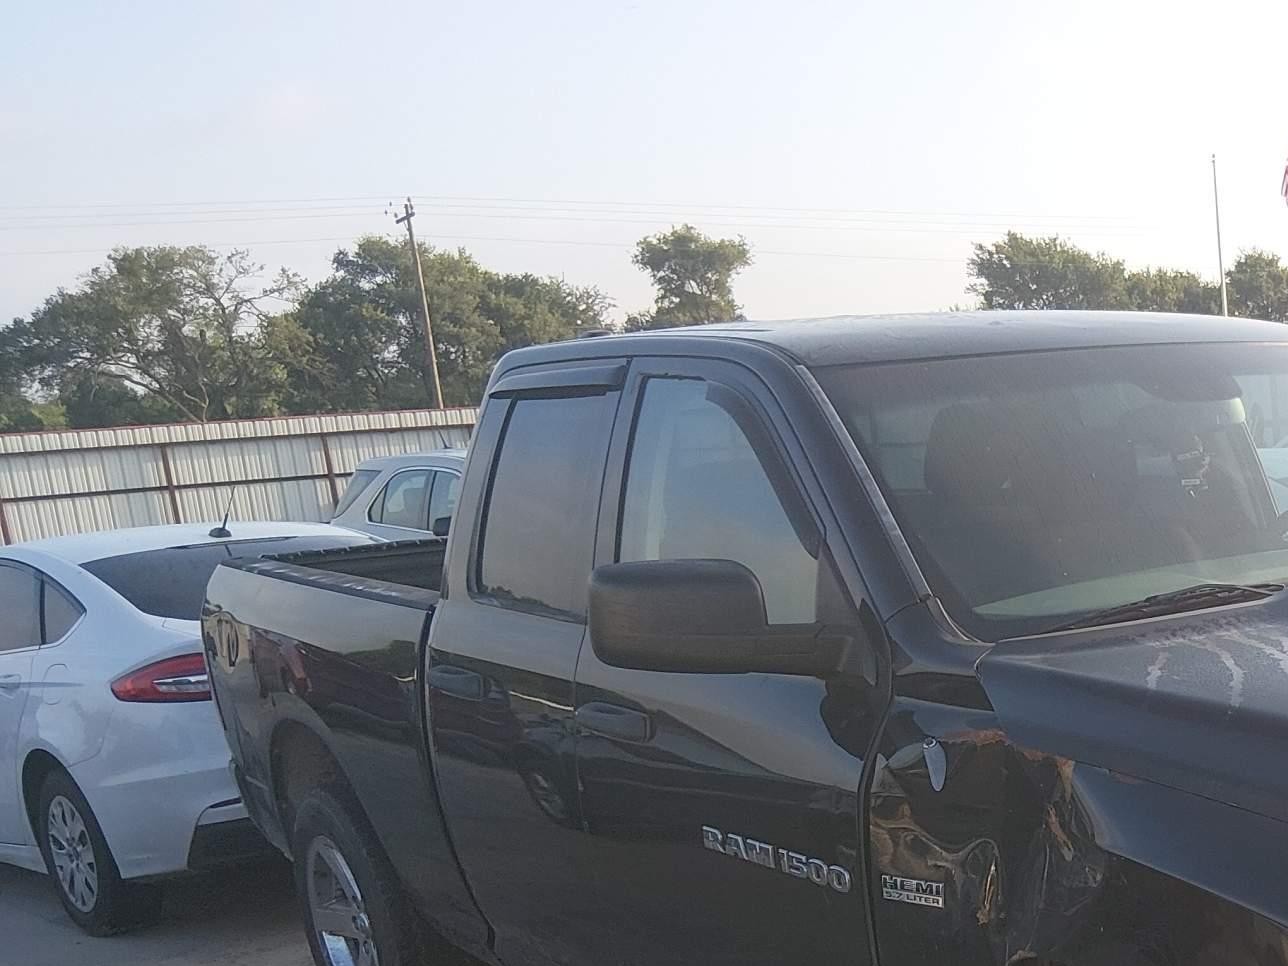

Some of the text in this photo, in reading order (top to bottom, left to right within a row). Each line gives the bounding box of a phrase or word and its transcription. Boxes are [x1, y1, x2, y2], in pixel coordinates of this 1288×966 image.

[702, 825, 851, 892] RAM 1500
[881, 874, 944, 897] HEMI
[884, 890, 942, 907] 5.7 LITER
